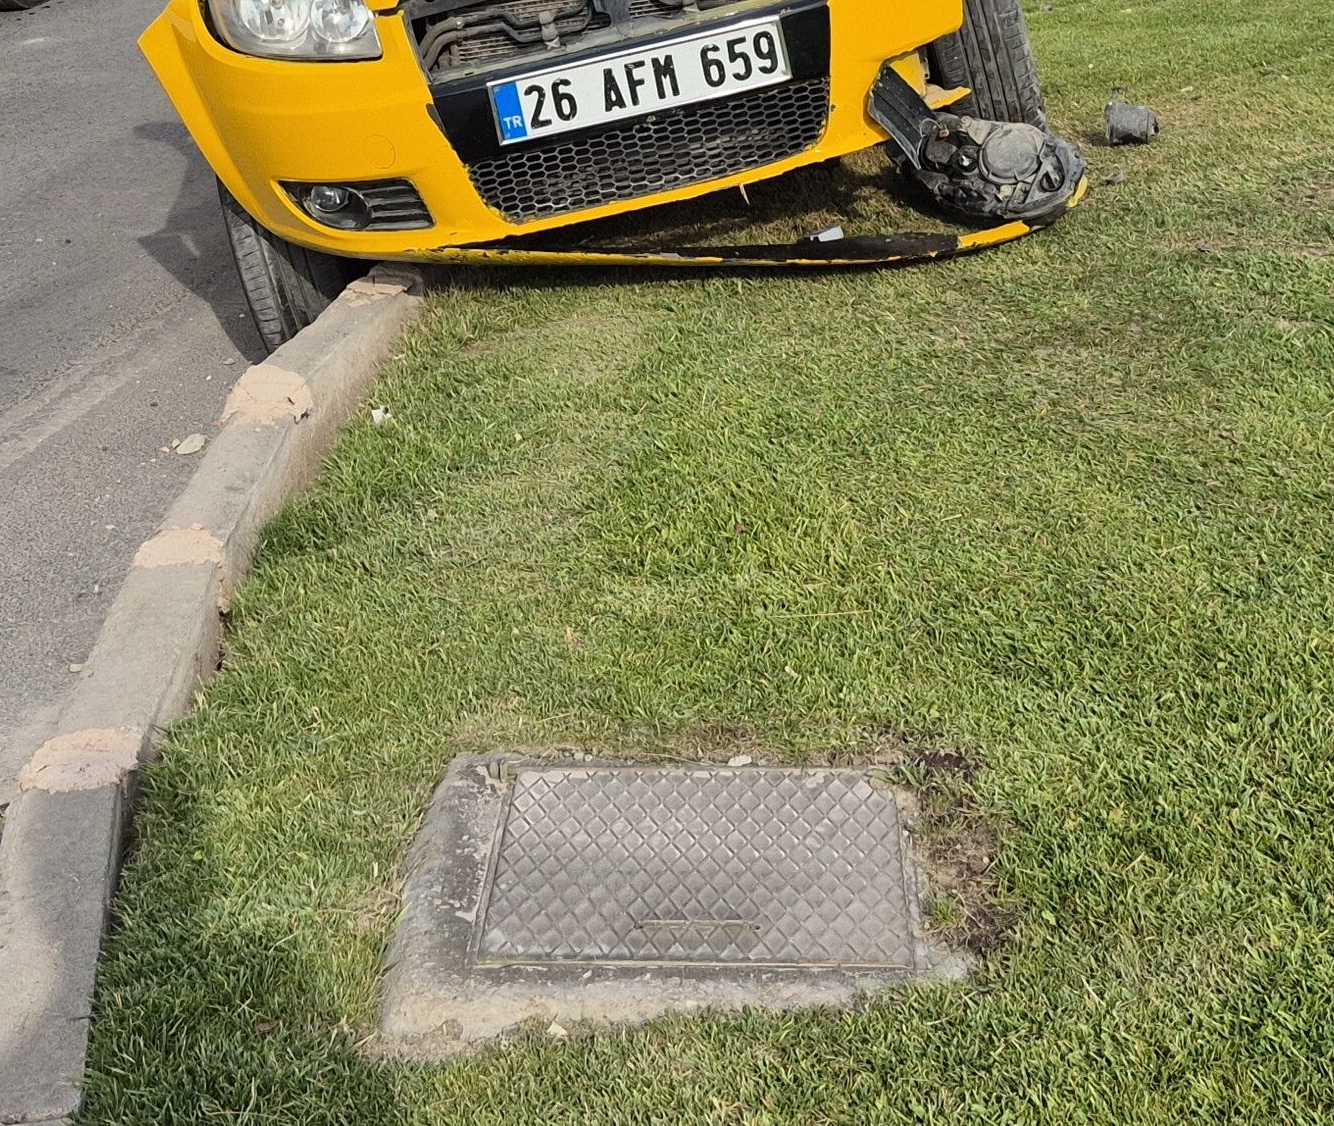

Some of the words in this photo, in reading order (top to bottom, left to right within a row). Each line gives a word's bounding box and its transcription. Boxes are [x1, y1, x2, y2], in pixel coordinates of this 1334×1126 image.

[524, 78, 577, 129] 26
[603, 54, 680, 113] AFM
[700, 30, 779, 88] 659
[503, 115, 523, 129] TR
